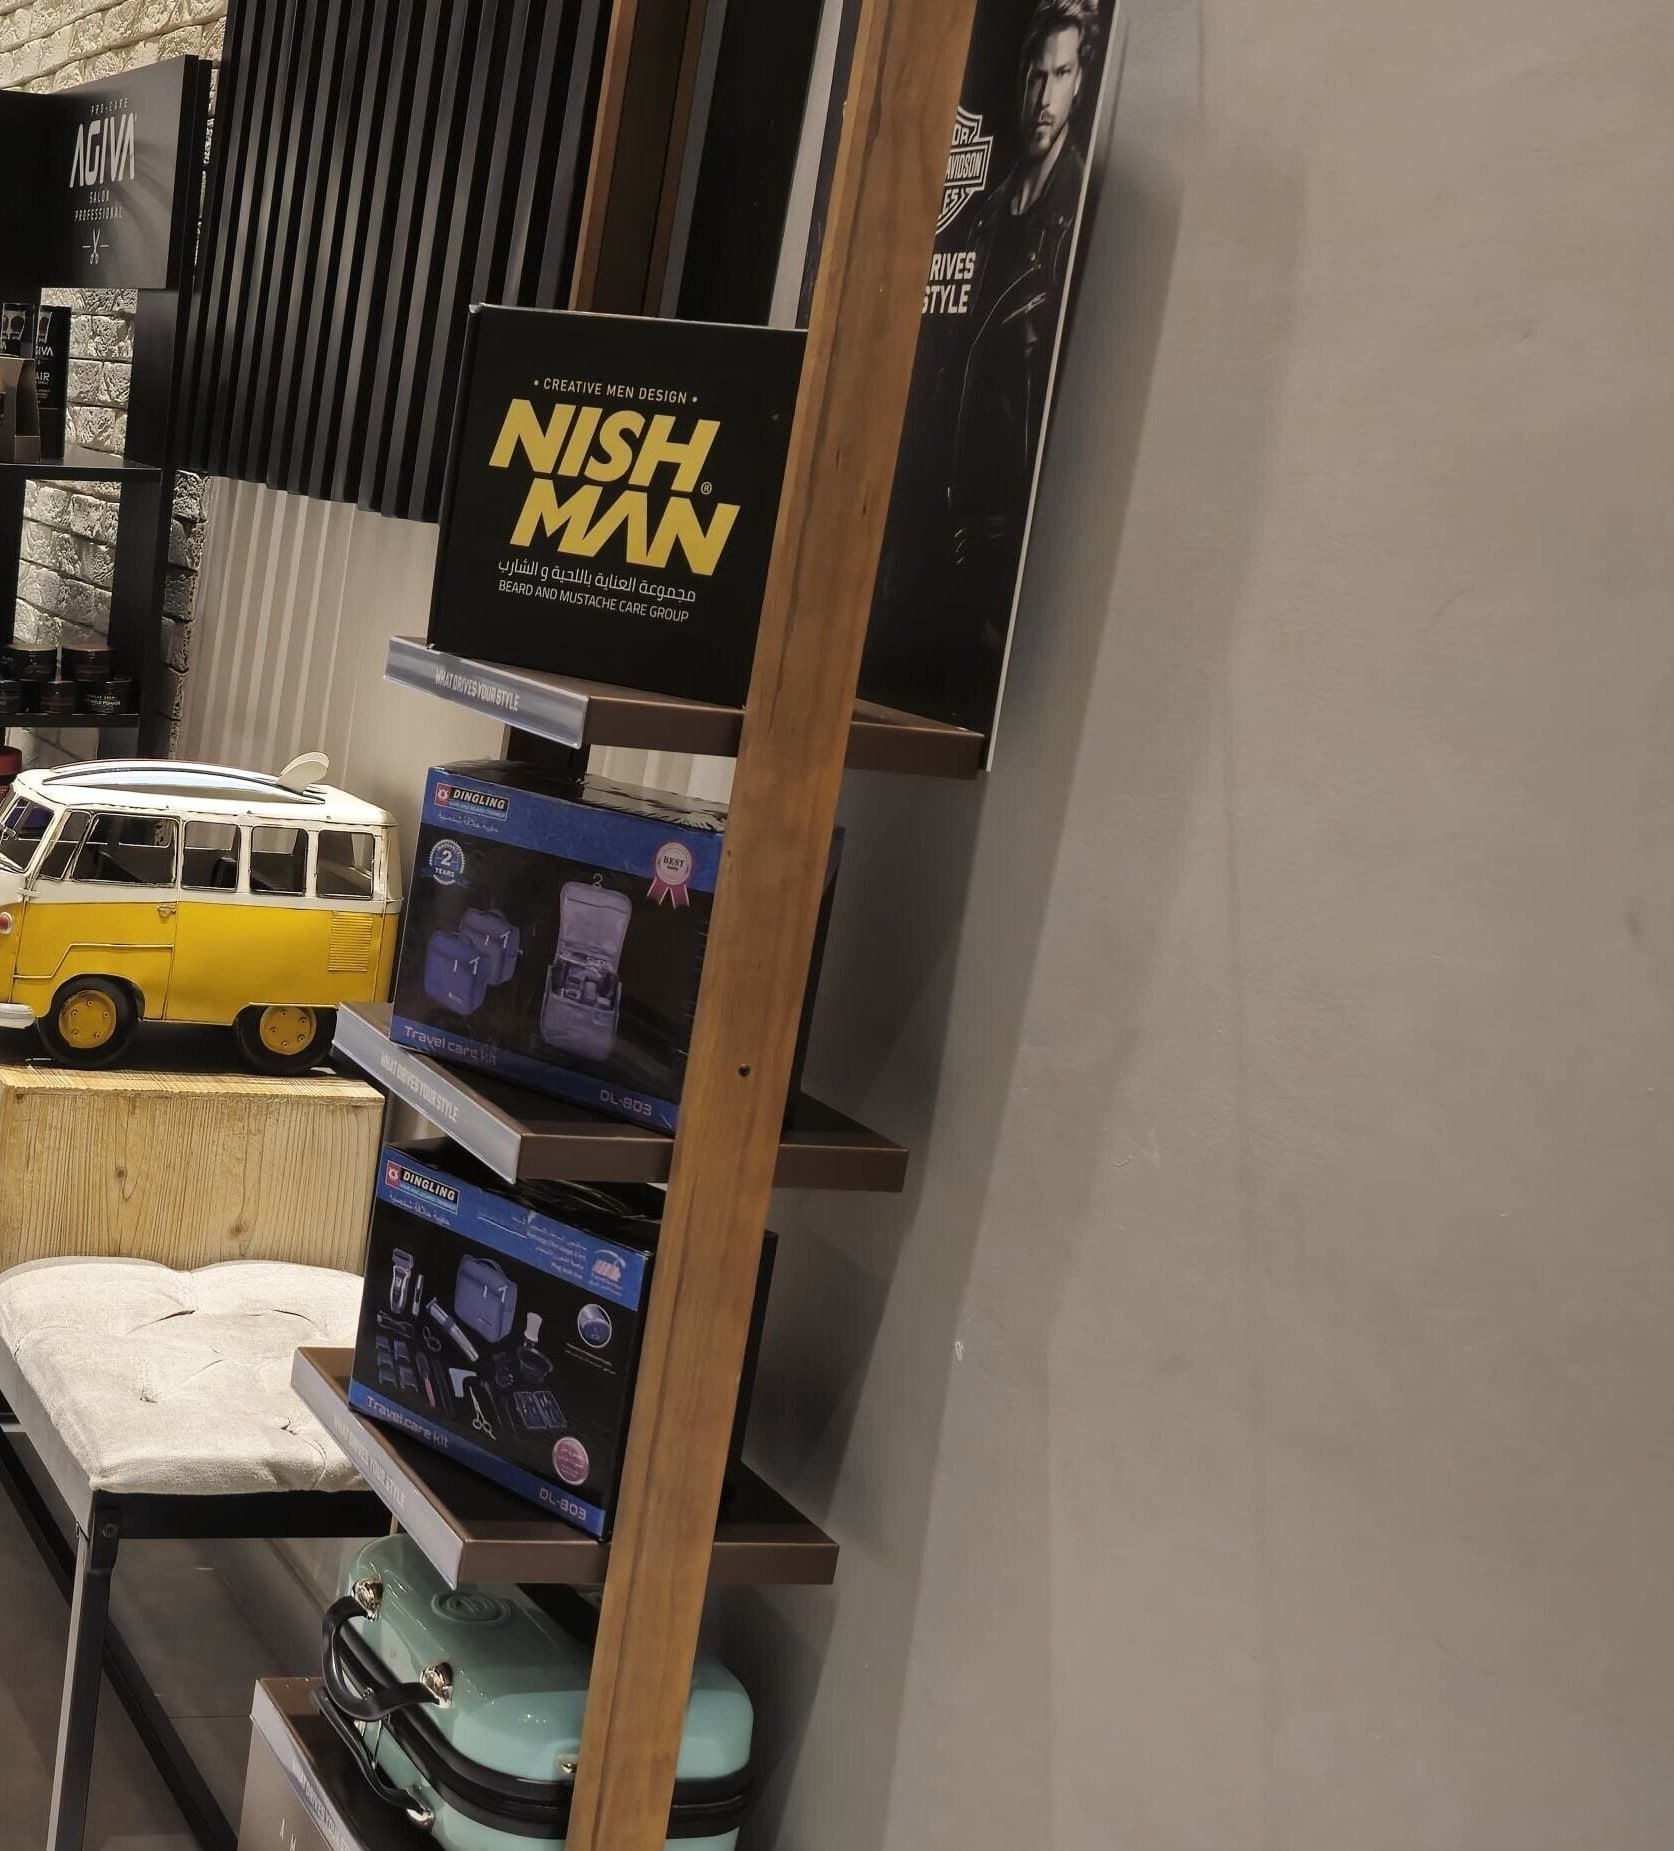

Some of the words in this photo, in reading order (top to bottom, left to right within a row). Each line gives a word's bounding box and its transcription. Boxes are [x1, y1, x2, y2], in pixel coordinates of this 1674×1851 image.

[69, 112, 135, 188] AGIVA
[946, 151, 983, 179] AVIDSON
[74, 206, 123, 221] PROFESSIONAL
[929, 252, 976, 280] RIVES
[543, 377, 603, 396] CREATIVE
[606, 384, 634, 399] MEN
[638, 387, 687, 404] DESIGN
[488, 398, 721, 493] NISH
[509, 477, 741, 576] MAN
[498, 557, 537, 577] الشارب
[541, 565, 548, 581] و
[551, 565, 591, 587] باللحية
[594, 570, 636, 593] العناية
[639, 580, 696, 604] مجموعة
[498, 580, 534, 596] BEARD
[535, 586, 558, 601] AND
[559, 591, 617, 611] MUSTACHE
[618, 599, 647, 616] CARE
[649, 605, 689, 623] GROUP
[435, 668, 454, 688] WHAT
[453, 674, 477, 697] DRIVES
[477, 681, 497, 705] YOUR
[496, 689, 520, 712] STYLE
[453, 789, 506, 810] DINGLING
[440, 849, 453, 867] 2
[435, 867, 455, 878] YEARS
[404, 1025, 446, 1049] Travel
[447, 1042, 479, 1059] care
[436, 1094, 460, 1122] STYLE
[403, 1171, 456, 1201] DINGLING
[367, 1396, 403, 1425] Travel
[404, 1418, 432, 1440] care
[433, 1431, 448, 1449] kit
